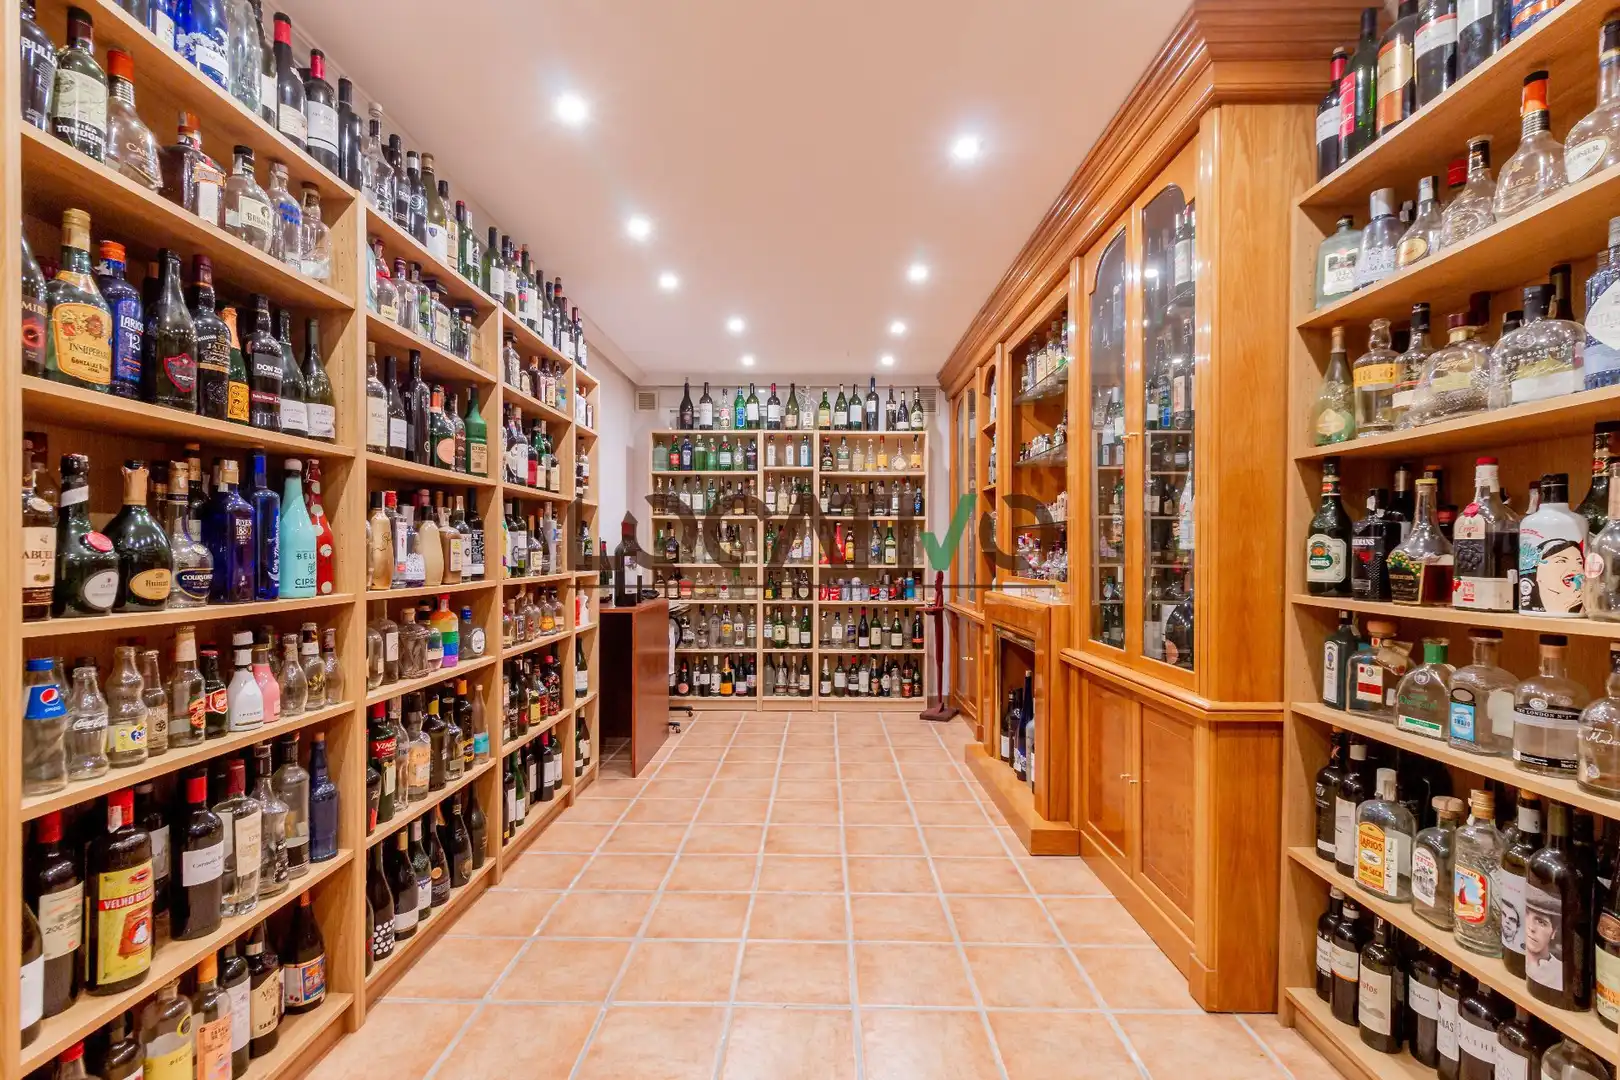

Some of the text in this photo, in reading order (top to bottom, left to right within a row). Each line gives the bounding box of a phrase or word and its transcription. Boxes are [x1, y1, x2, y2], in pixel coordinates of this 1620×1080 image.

[120, 315, 144, 333] LARIOS
[256, 363, 273, 374] DON
[41, 559, 47, 567] 7
[1527, 709, 1555, 718] LONDON
[1360, 835, 1383, 852] LARIOS
[104, 896, 134, 910] VELHO
